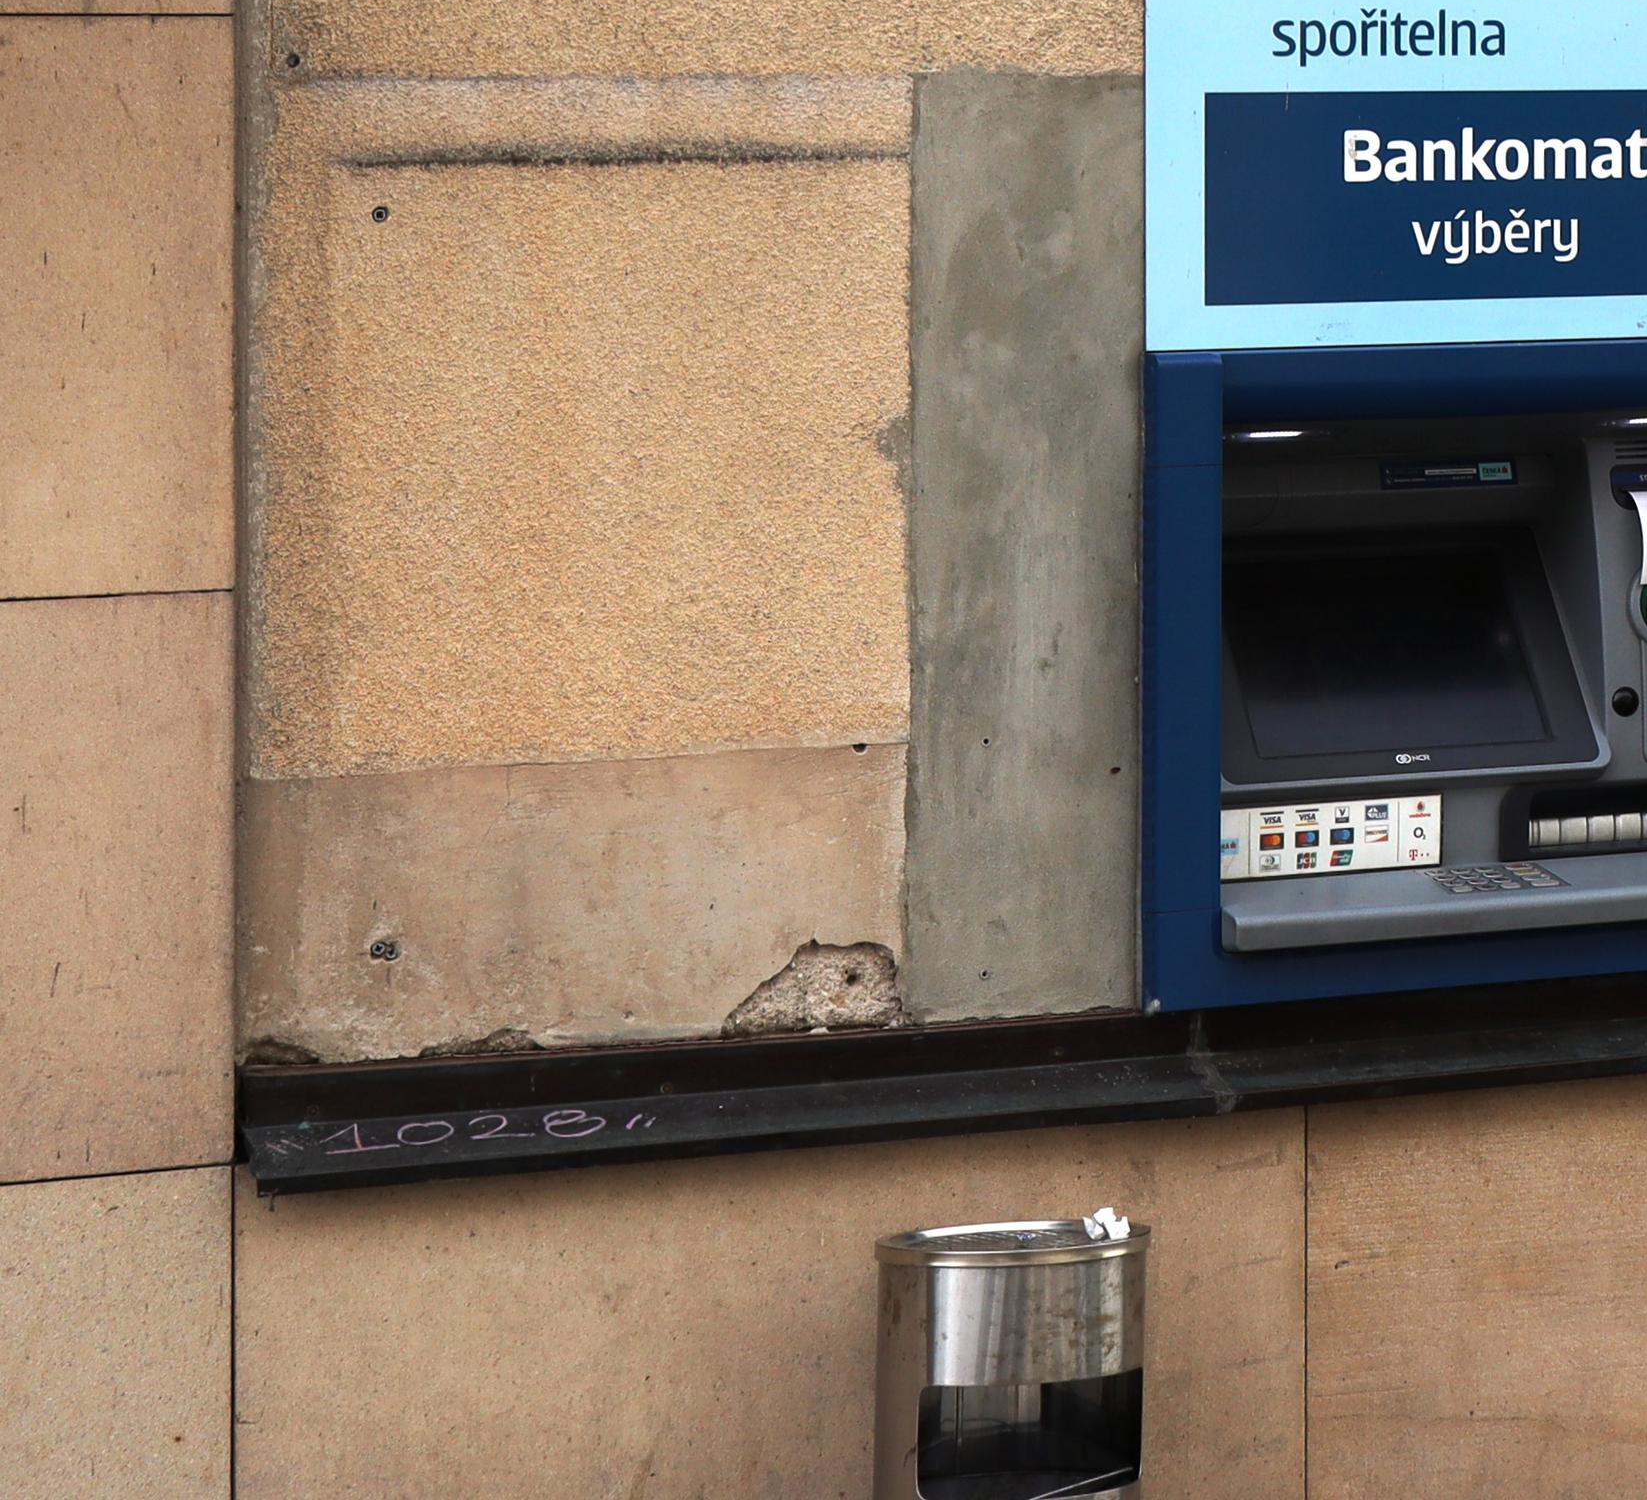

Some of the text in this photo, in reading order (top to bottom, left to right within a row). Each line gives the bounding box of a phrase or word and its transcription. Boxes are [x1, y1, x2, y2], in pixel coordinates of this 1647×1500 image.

[1272, 8, 1506, 68] spořitelna
[1411, 208, 1579, 265] výběry
[1263, 816, 1282, 824] VISA
[1299, 813, 1316, 821] VISA
